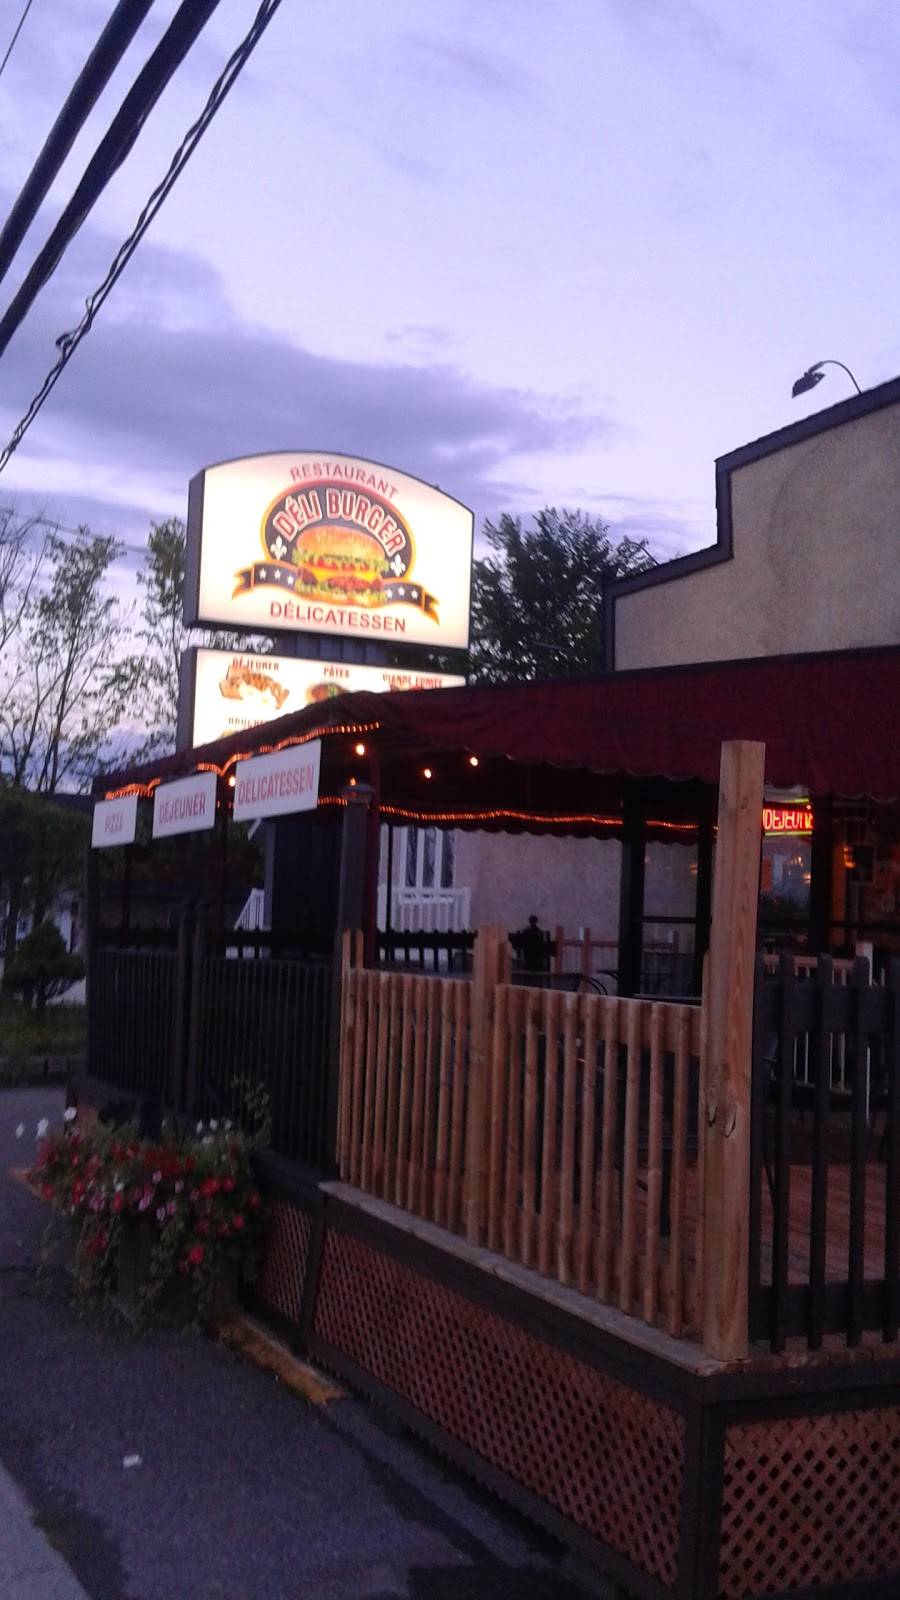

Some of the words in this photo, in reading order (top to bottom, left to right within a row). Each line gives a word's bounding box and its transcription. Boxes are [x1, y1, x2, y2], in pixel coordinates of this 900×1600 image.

[290, 462, 398, 499] RESTAURANT
[272, 488, 322, 542] DÉLI
[326, 487, 406, 557] BURGER
[270, 600, 406, 633] DÉLICATESSEN
